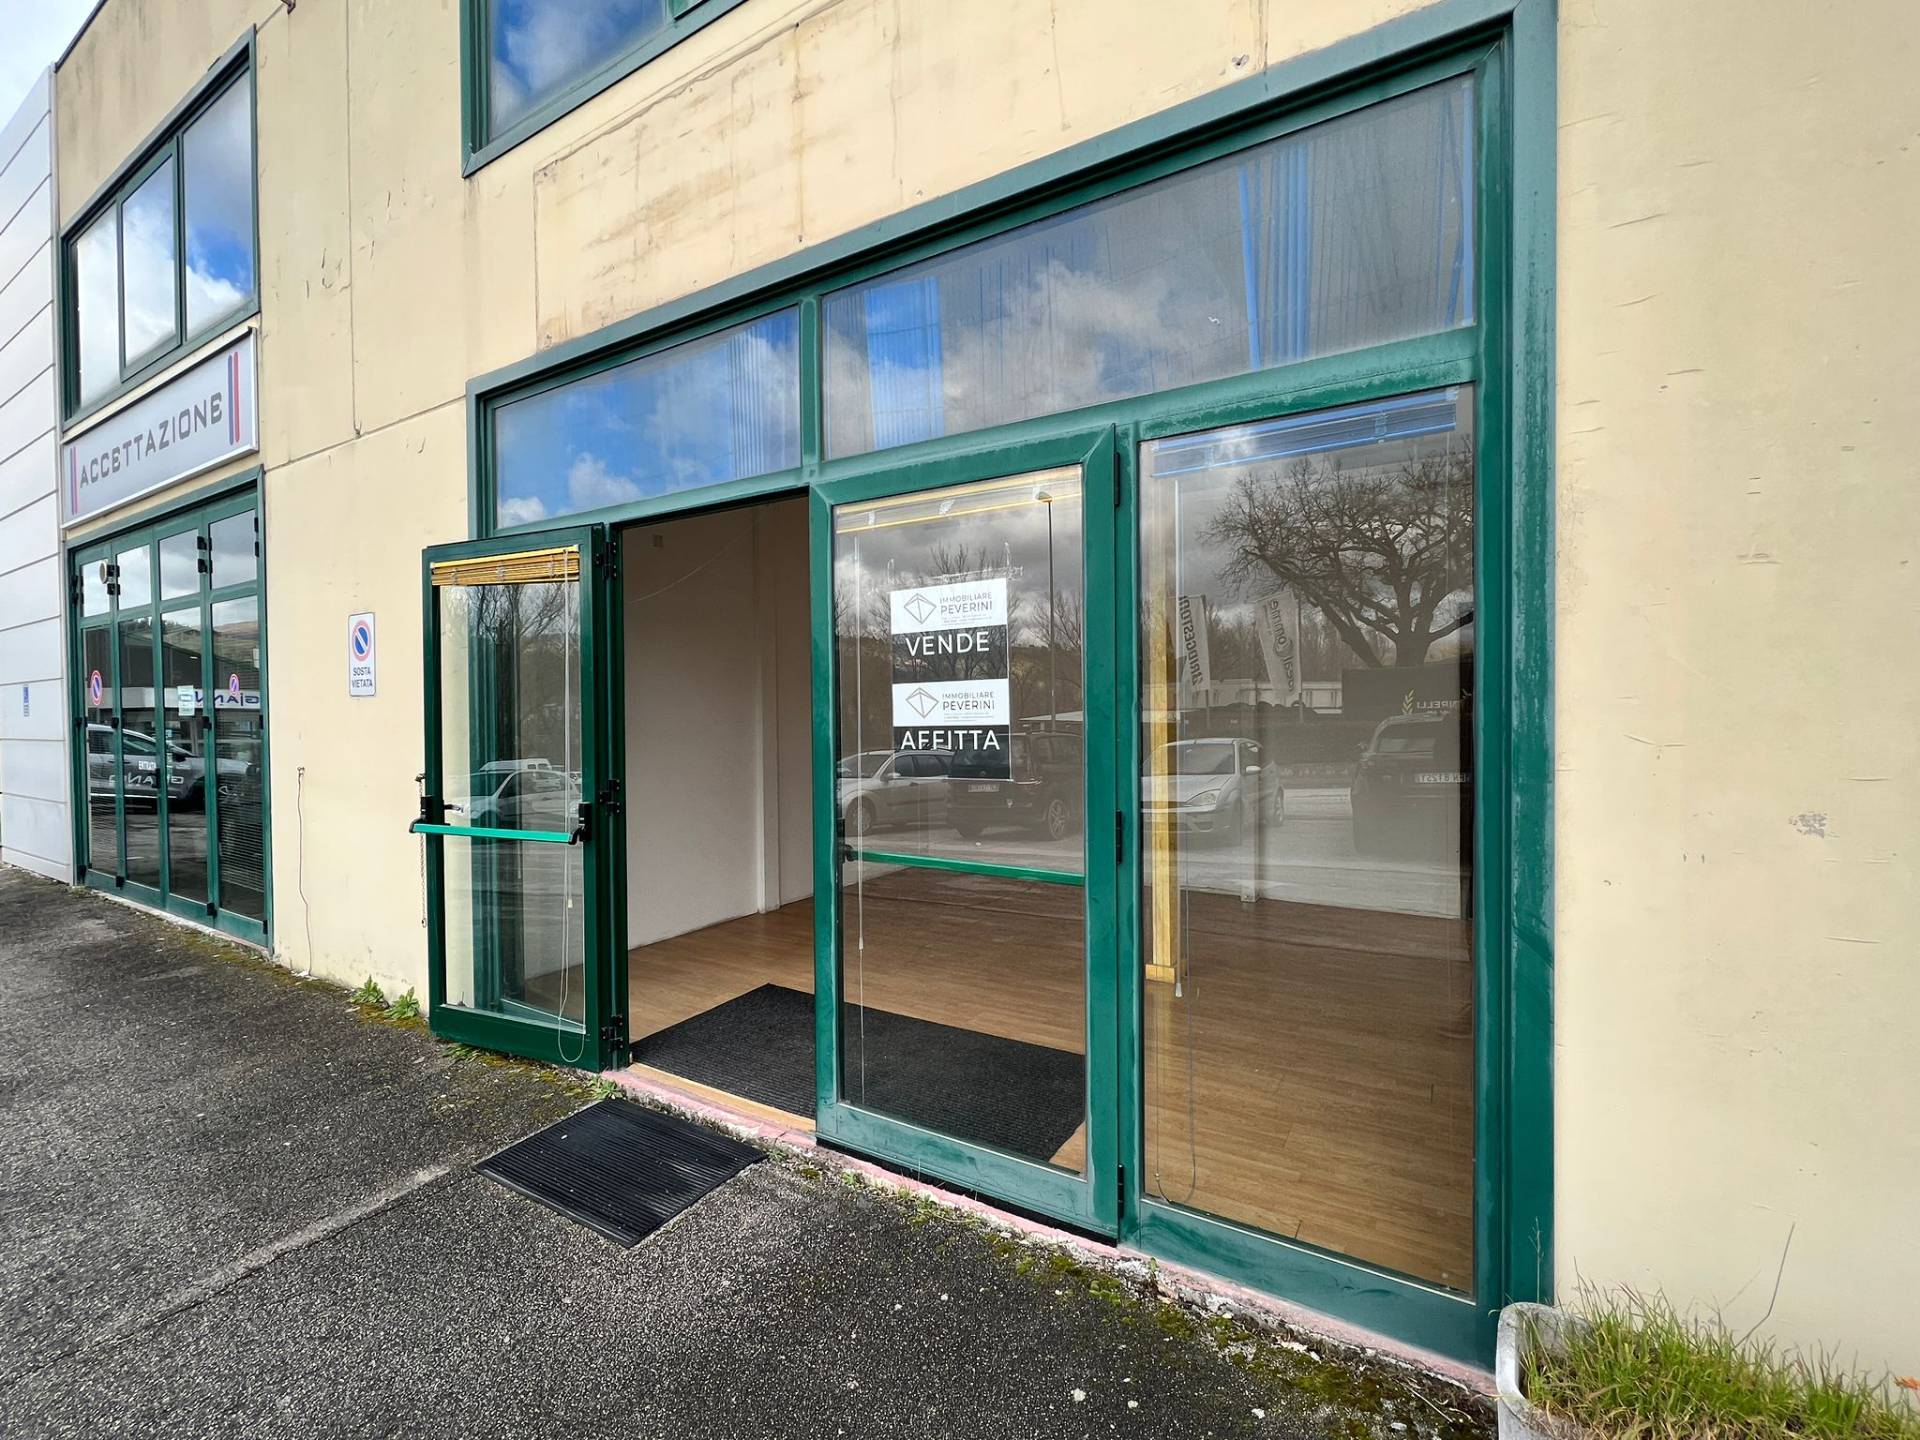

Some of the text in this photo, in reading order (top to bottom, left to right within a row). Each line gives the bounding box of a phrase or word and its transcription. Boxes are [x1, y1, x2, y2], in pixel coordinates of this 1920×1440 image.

[79, 391, 223, 488] ACCETTAZIONE
[939, 592, 992, 604] IMMOBILIARE
[940, 600, 993, 615] PEVERINI
[905, 631, 990, 657] VENDE
[353, 666, 371, 676] SOSTA
[352, 678, 373, 688] VIETATA
[942, 691, 995, 700] IMMOBILIARE
[942, 699, 995, 711] PEVERINI
[901, 729, 1000, 751] AFFITTA
